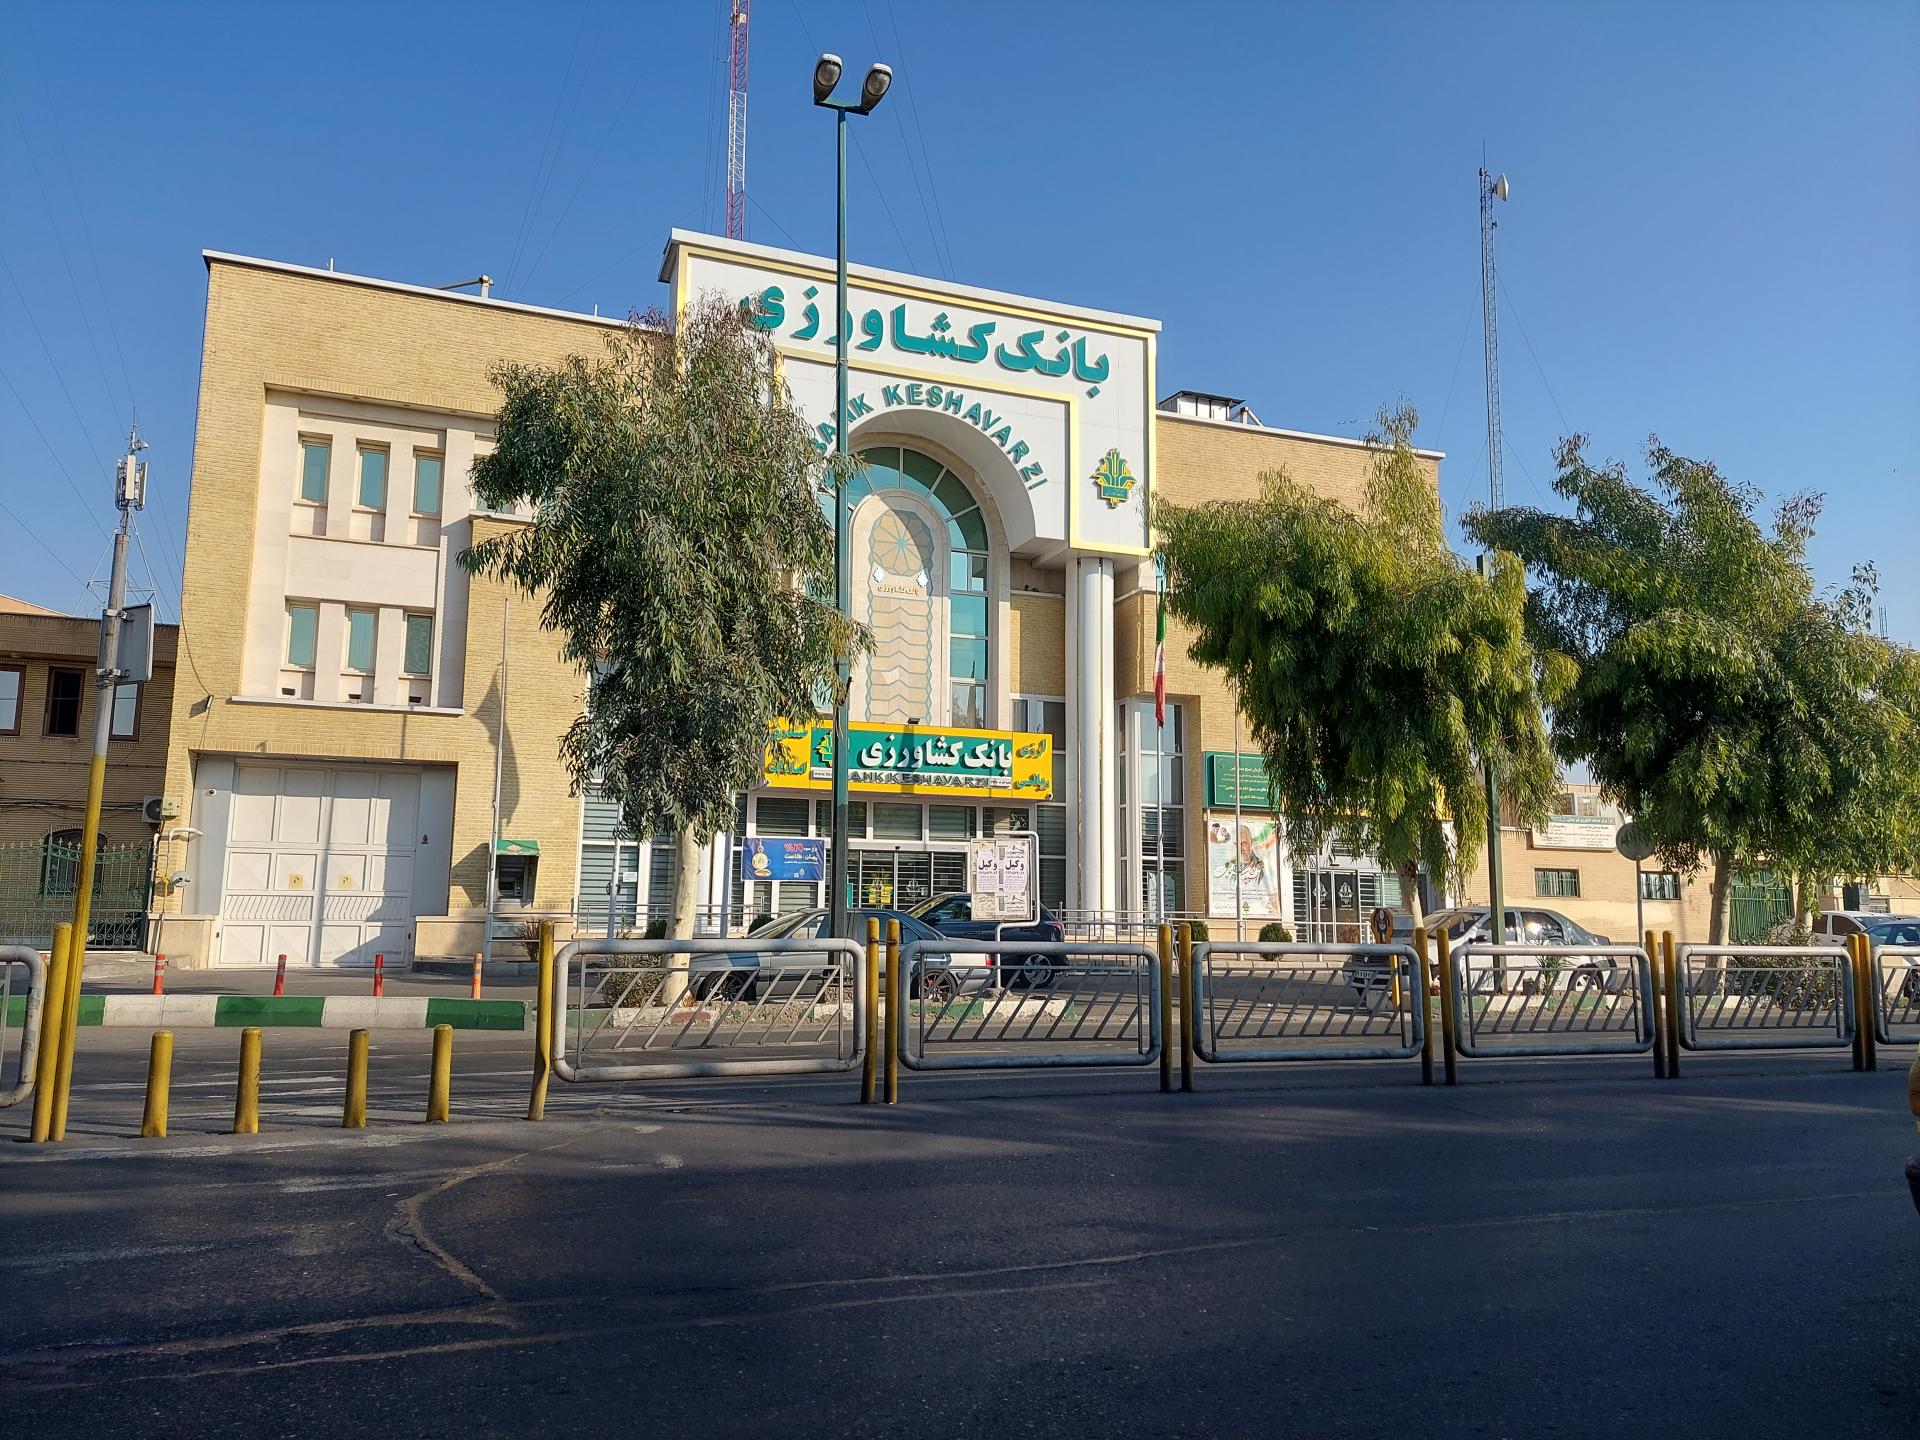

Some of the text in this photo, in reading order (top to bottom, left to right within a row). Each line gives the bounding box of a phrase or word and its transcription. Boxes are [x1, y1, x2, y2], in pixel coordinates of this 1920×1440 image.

[741, 285, 1110, 399] بانک کشاورزی
[881, 383, 1049, 491] KESHAVARZI
[861, 733, 1013, 776] بانک کشاورزی
[848, 771, 885, 784] ANK
[887, 772, 990, 788] KESHAVARZI
[978, 860, 998, 870] وکیل
[1005, 860, 1025, 870] وکیل
